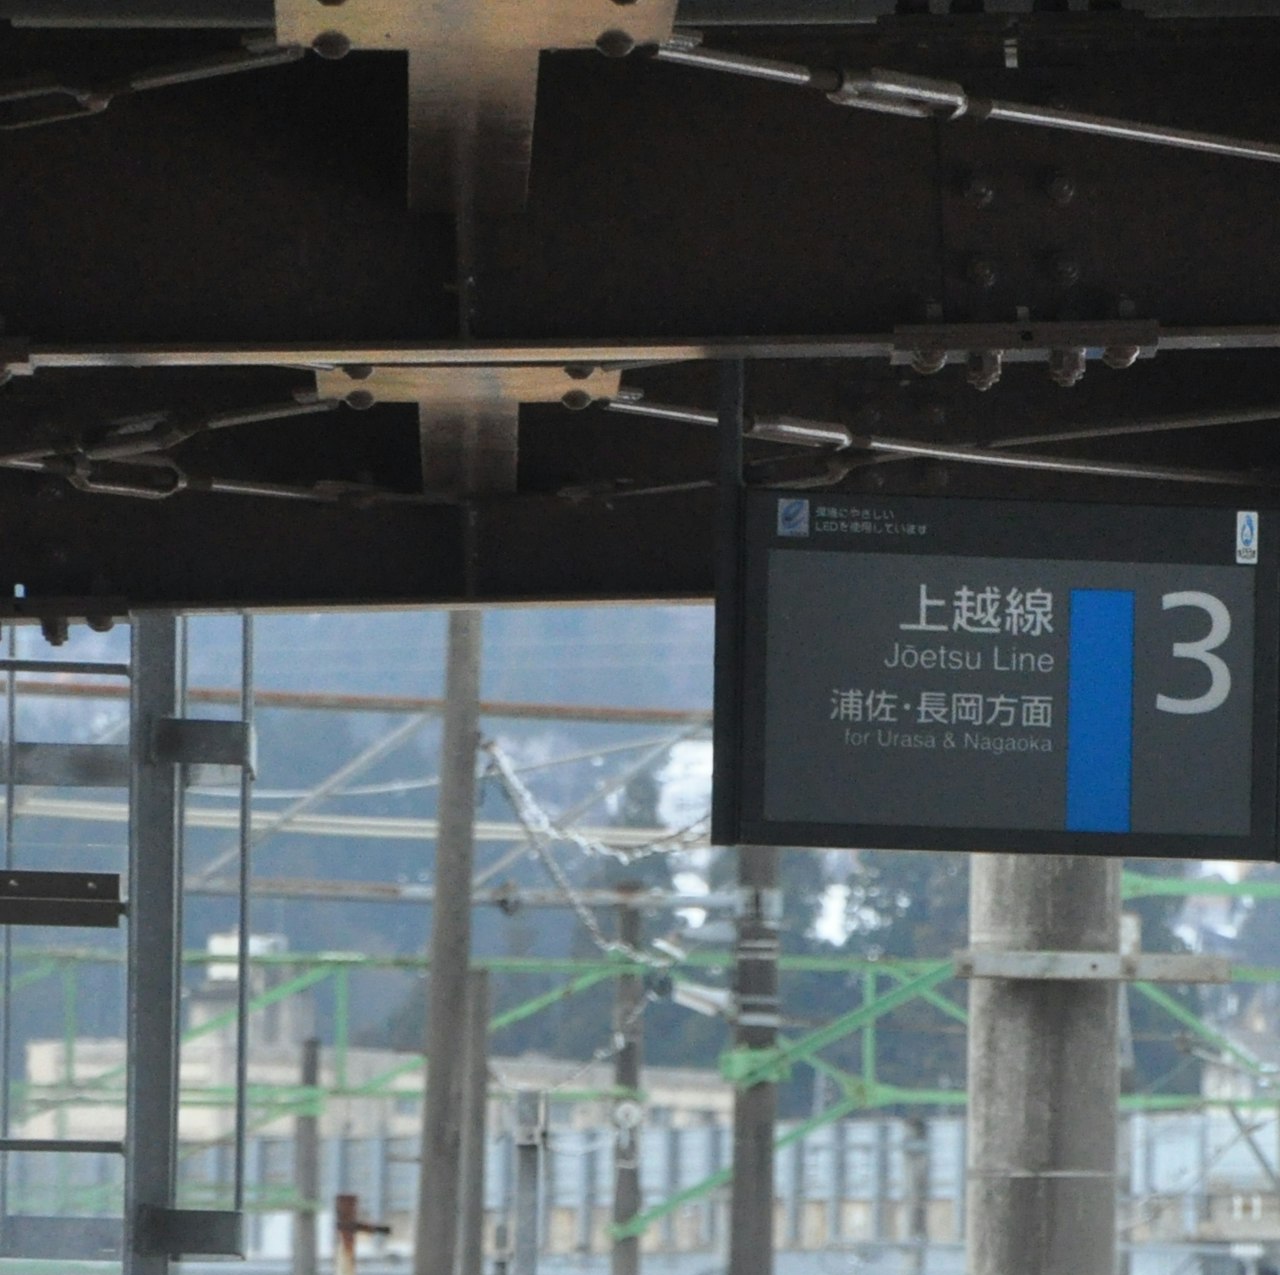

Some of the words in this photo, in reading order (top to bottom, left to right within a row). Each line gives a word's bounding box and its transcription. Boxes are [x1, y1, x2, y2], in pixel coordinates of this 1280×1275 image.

[899, 583, 1054, 636] 上越線
[883, 642, 982, 670] Jōetsu
[993, 645, 1055, 673] Line
[1155, 590, 1232, 714] 3
[829, 688, 1053, 728] 浦佐・長岡方面
[844, 728, 871, 746] for
[877, 729, 936, 749] Urasa
[943, 732, 956, 749] &
[964, 732, 1053, 755] Nagaoka
